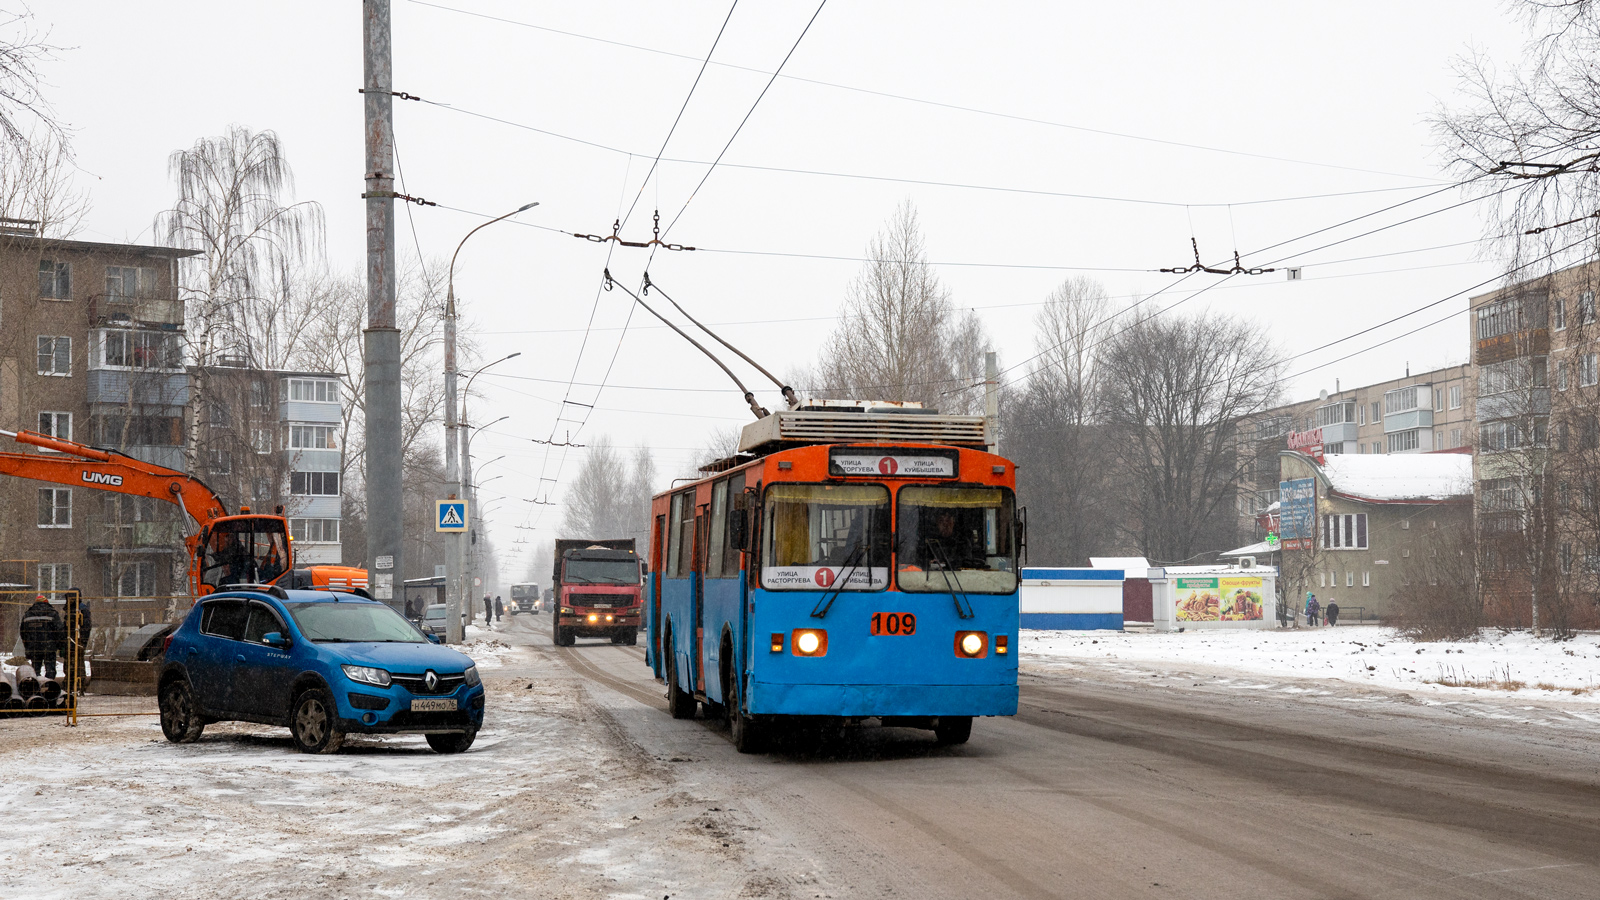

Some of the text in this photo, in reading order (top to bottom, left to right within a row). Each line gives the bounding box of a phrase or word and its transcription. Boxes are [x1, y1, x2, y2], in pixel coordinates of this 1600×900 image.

[883, 459, 892, 474] 1
[82, 471, 123, 486] UMG
[819, 570, 828, 586] 1
[1221, 579, 1261, 588] Овощи-фрукты
[871, 613, 916, 635] 109
[266, 652, 292, 660] STEPWAY
